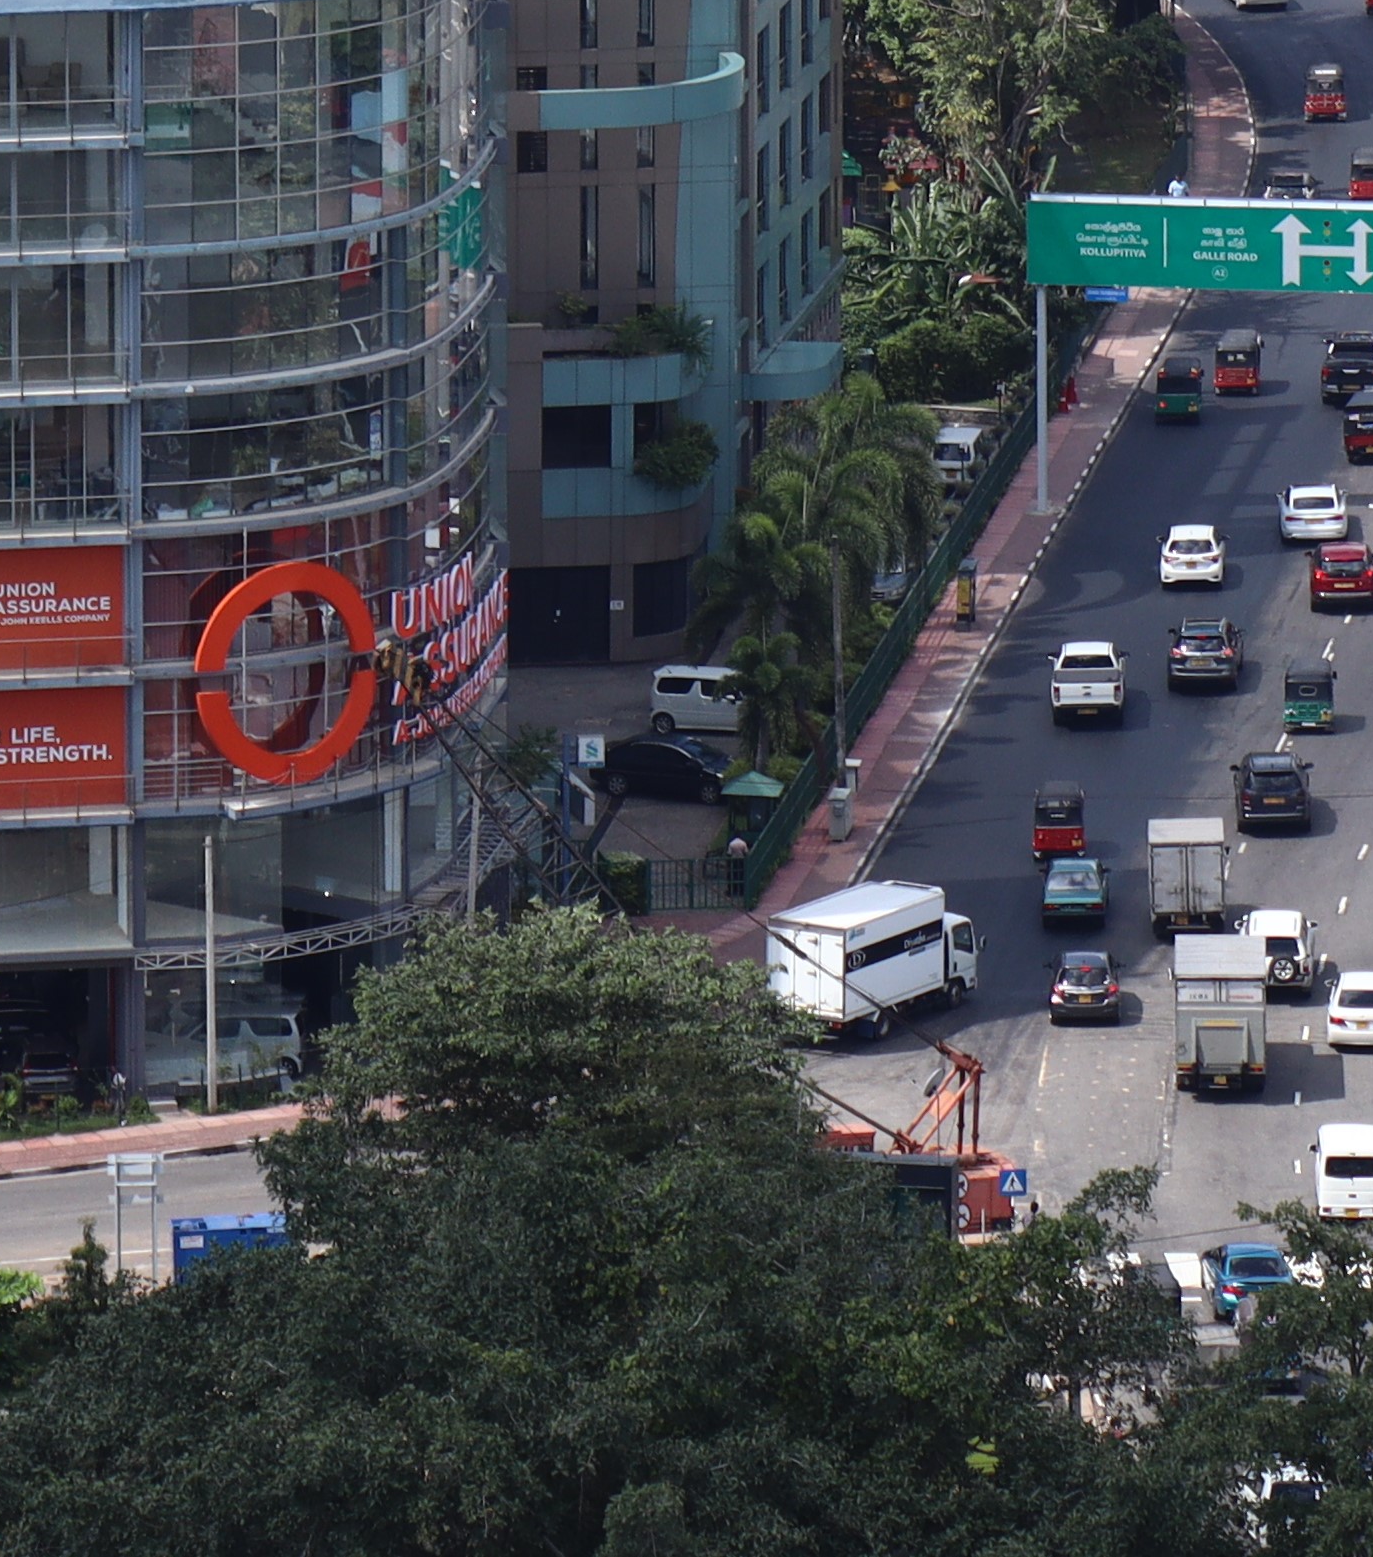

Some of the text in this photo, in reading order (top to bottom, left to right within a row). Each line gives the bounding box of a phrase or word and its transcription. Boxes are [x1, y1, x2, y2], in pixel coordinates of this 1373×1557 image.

[1079, 246, 1146, 258] KOLLUPITIYA
[1193, 250, 1258, 262] GALLE ROAD
[391, 551, 474, 640] UNION
[0, 617, 27, 626] JOHN
[29, 616, 63, 625] KEELLS
[64, 613, 110, 623] COMPANY
[11, 726, 60, 744] LIFE,
